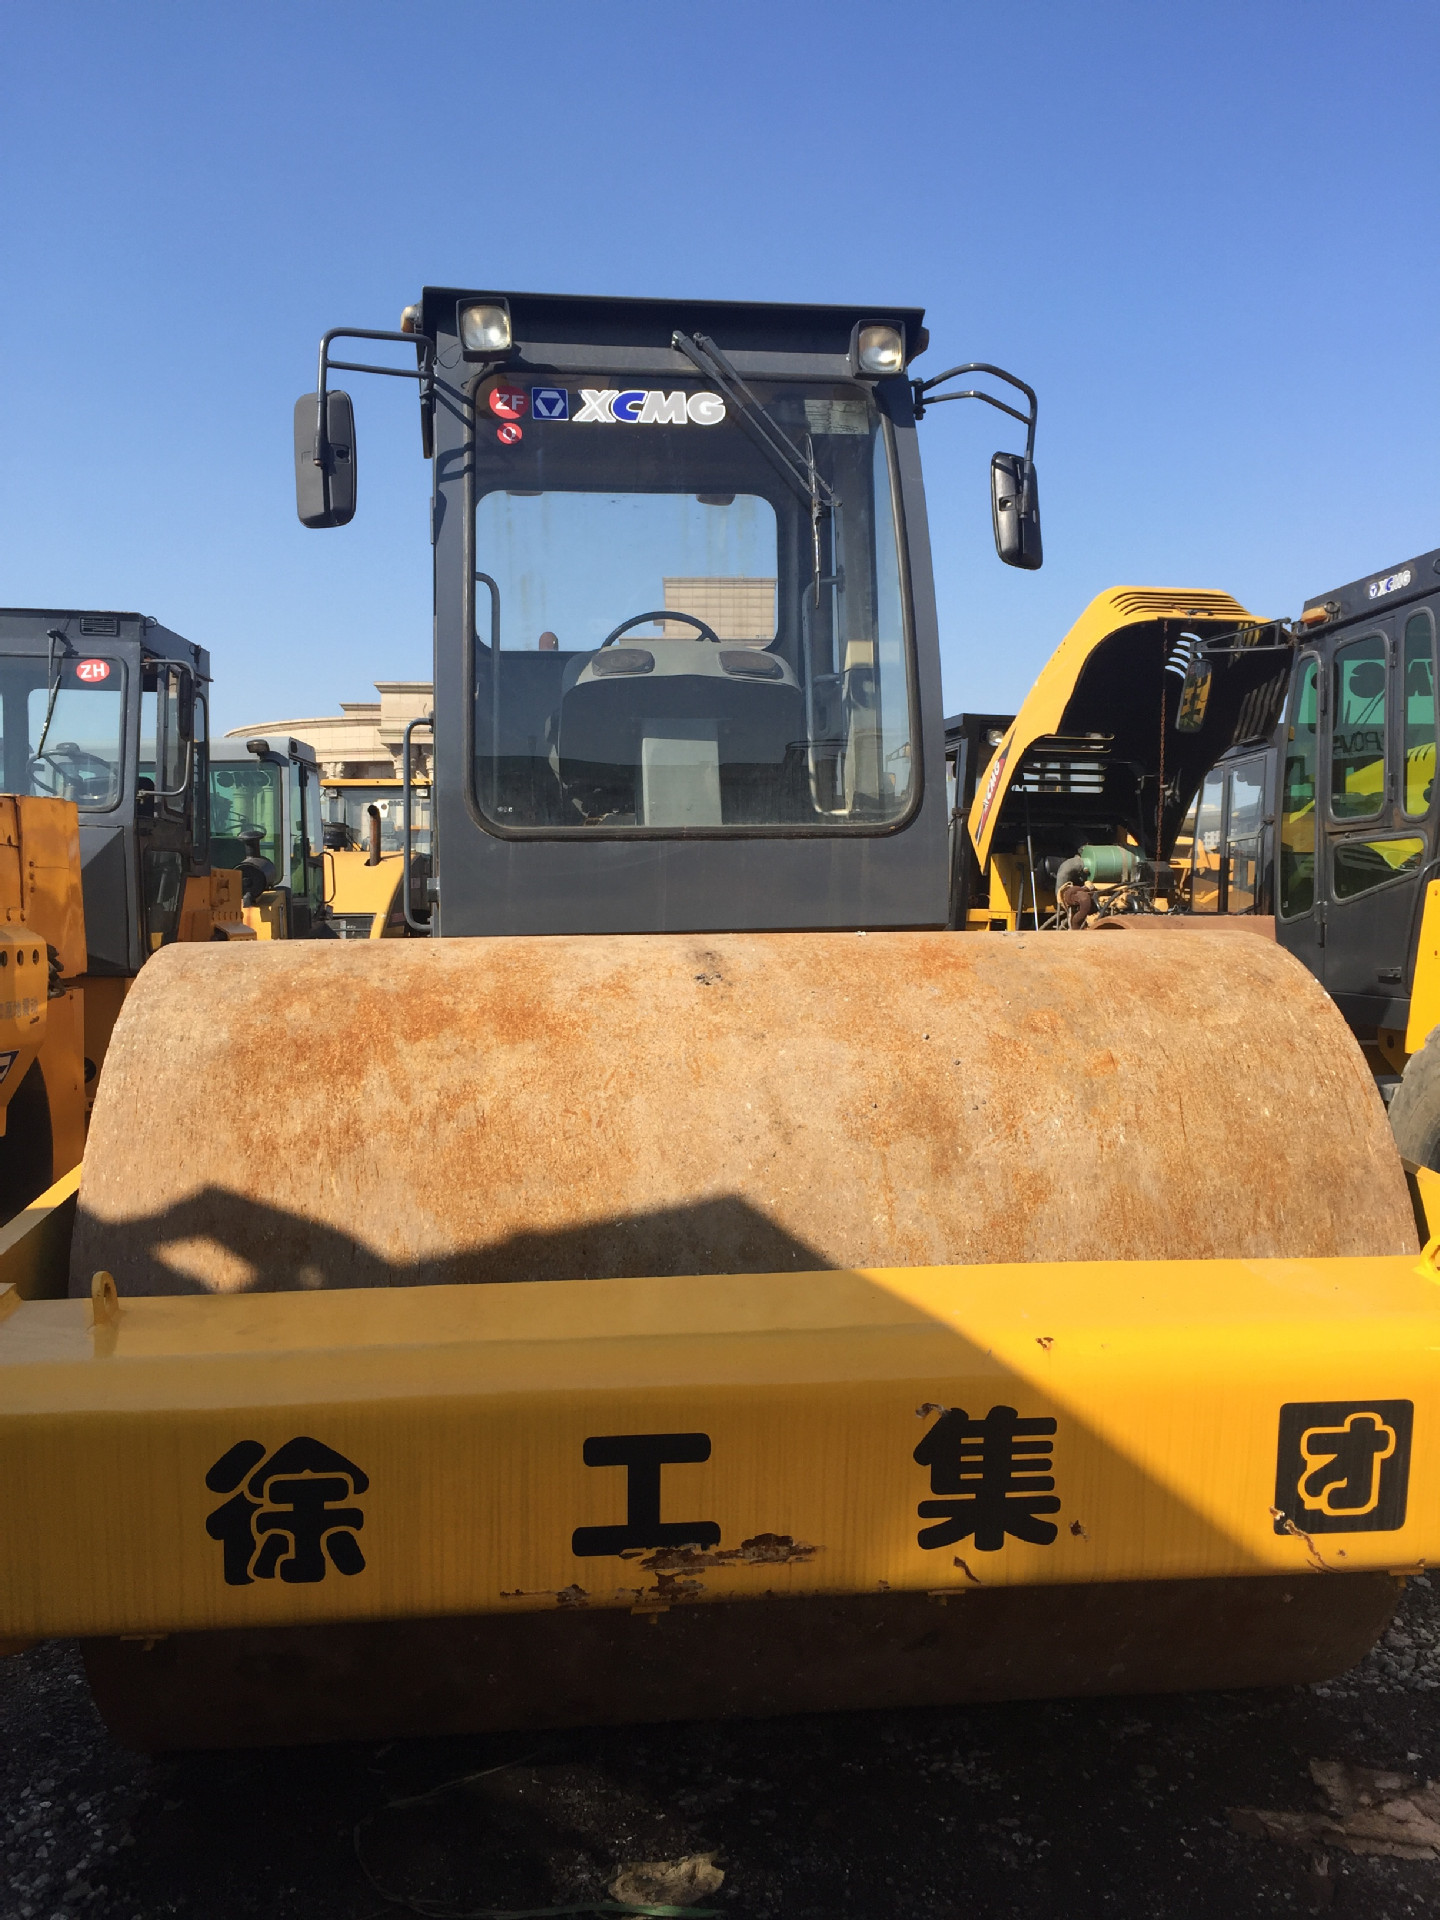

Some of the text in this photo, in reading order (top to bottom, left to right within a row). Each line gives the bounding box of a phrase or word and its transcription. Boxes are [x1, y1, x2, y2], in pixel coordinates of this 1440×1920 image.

[495, 393, 525, 410] ZF
[571, 389, 726, 425] XCMG
[80, 662, 105, 679] ZH
[205, 1399, 1414, 1586] 徐工集团
